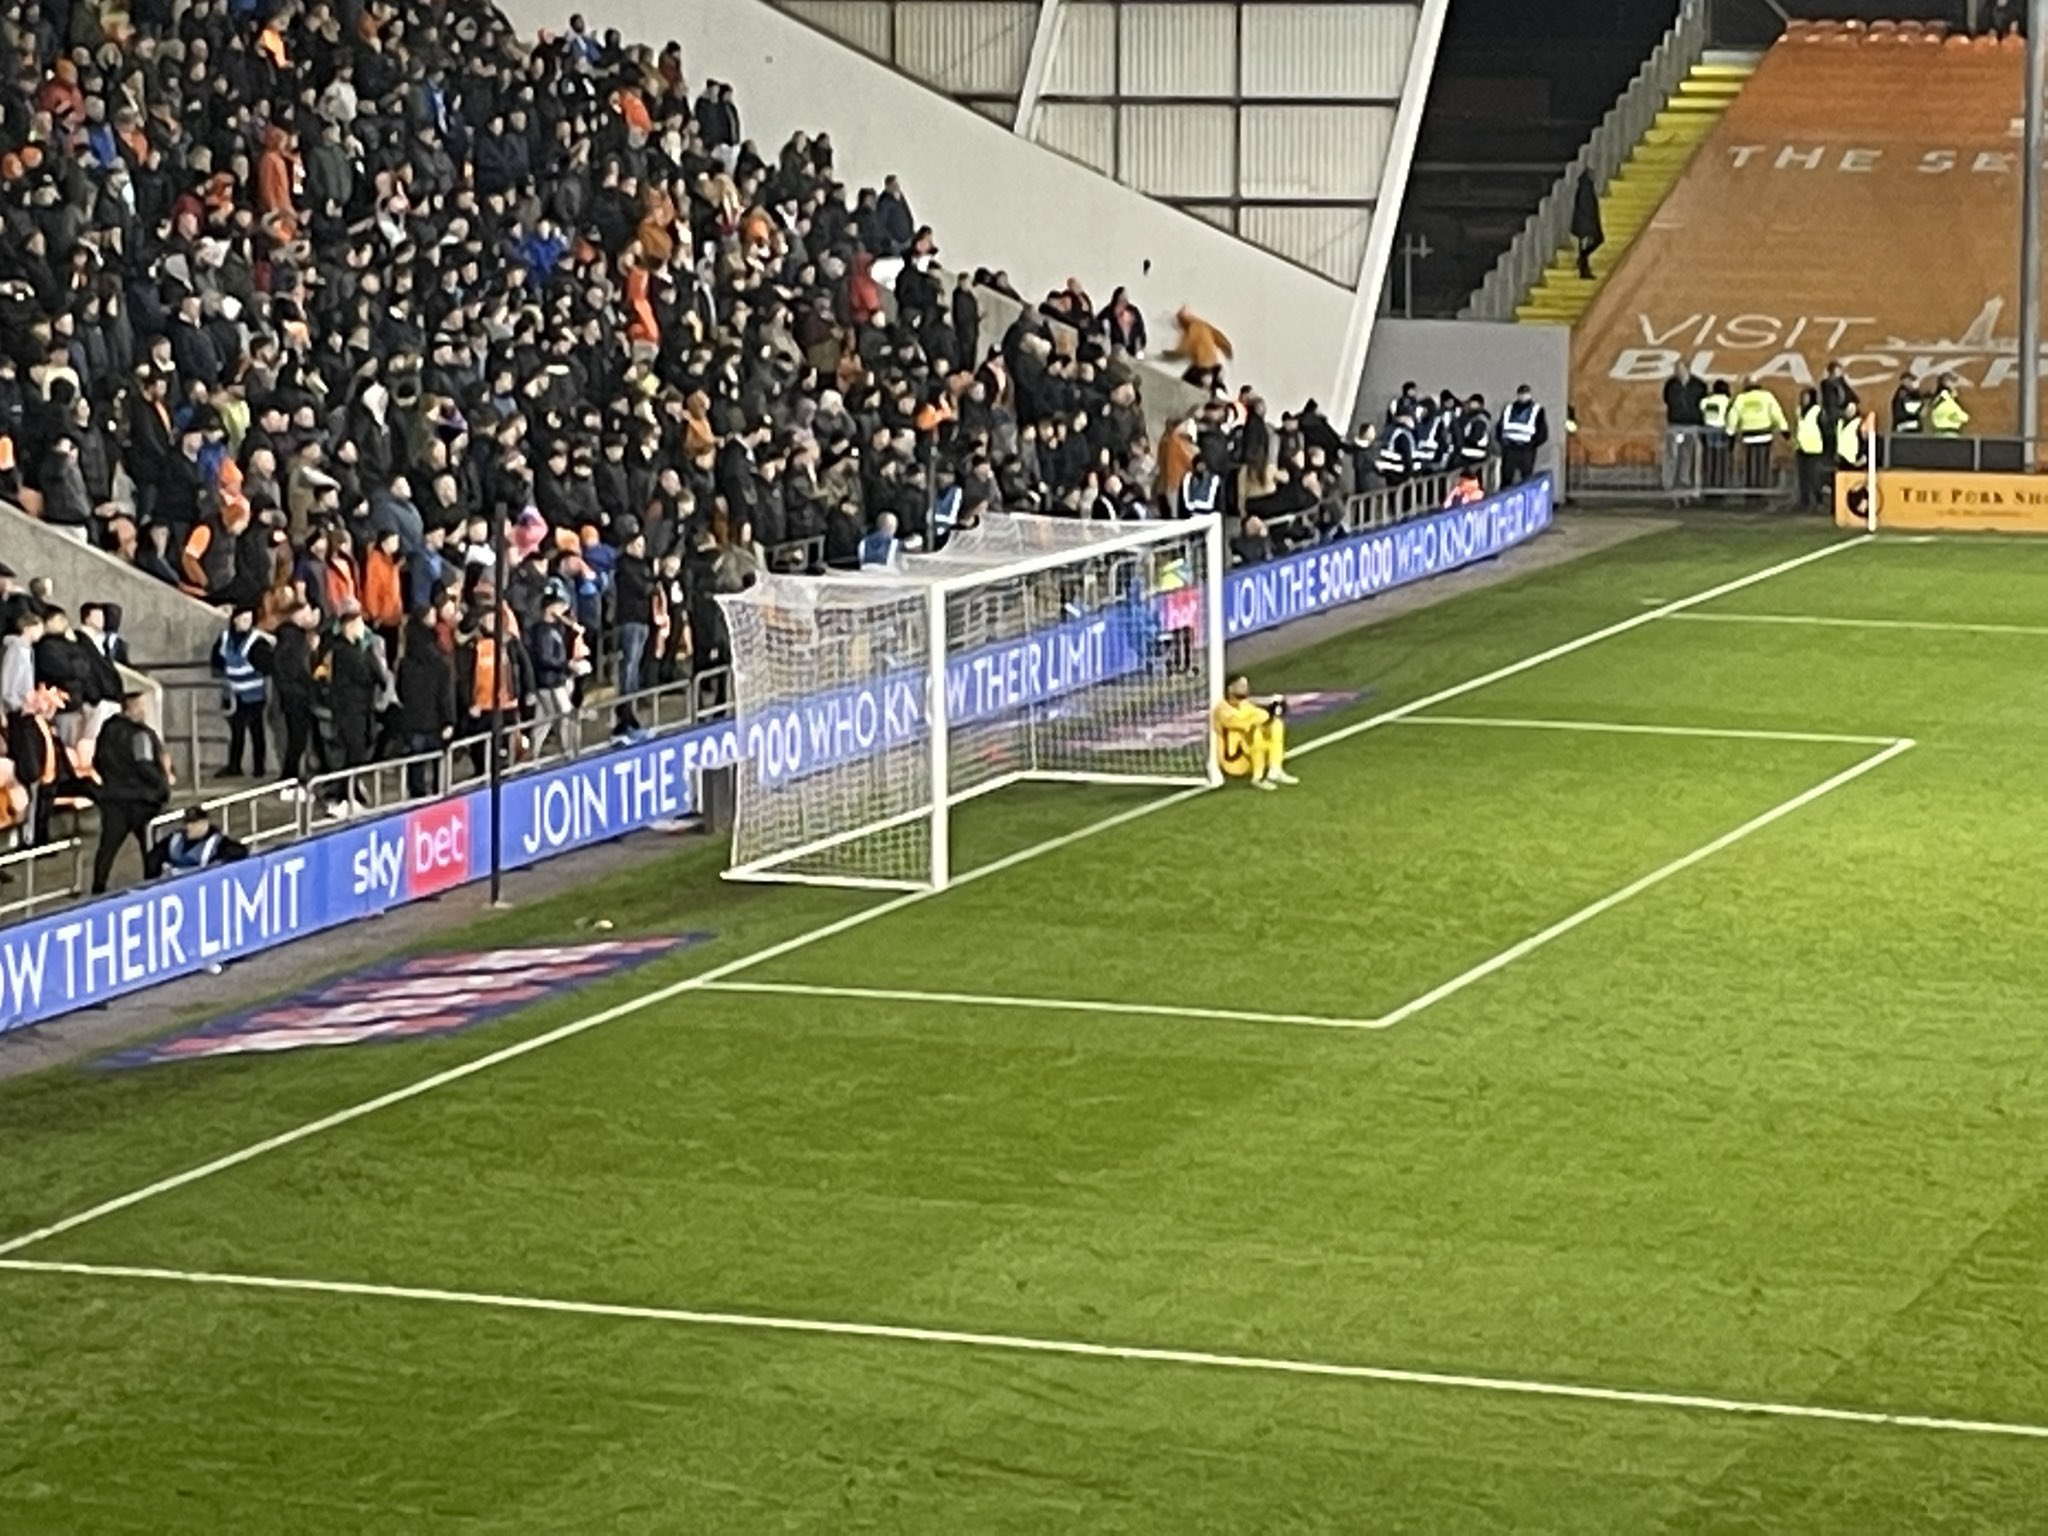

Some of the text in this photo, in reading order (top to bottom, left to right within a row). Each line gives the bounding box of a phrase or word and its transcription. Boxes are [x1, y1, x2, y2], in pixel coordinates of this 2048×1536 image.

[1728, 145, 2048, 174] THE SE
[1638, 313, 1877, 350] VISIT
[1228, 568, 1277, 633] JOIN
[1279, 556, 1316, 620] THE
[1319, 536, 1393, 604] 500,000
[1395, 522, 1438, 580] WHO
[523, 766, 608, 854] JOIN
[613, 748, 677, 826] THE
[807, 691, 878, 760] WHO
[972, 642, 1042, 715] THEIR
[1046, 621, 1106, 691] LIMIT
[353, 814, 464, 899] sky bet
[0, 857, 306, 1016] W THEIR LIMIT
